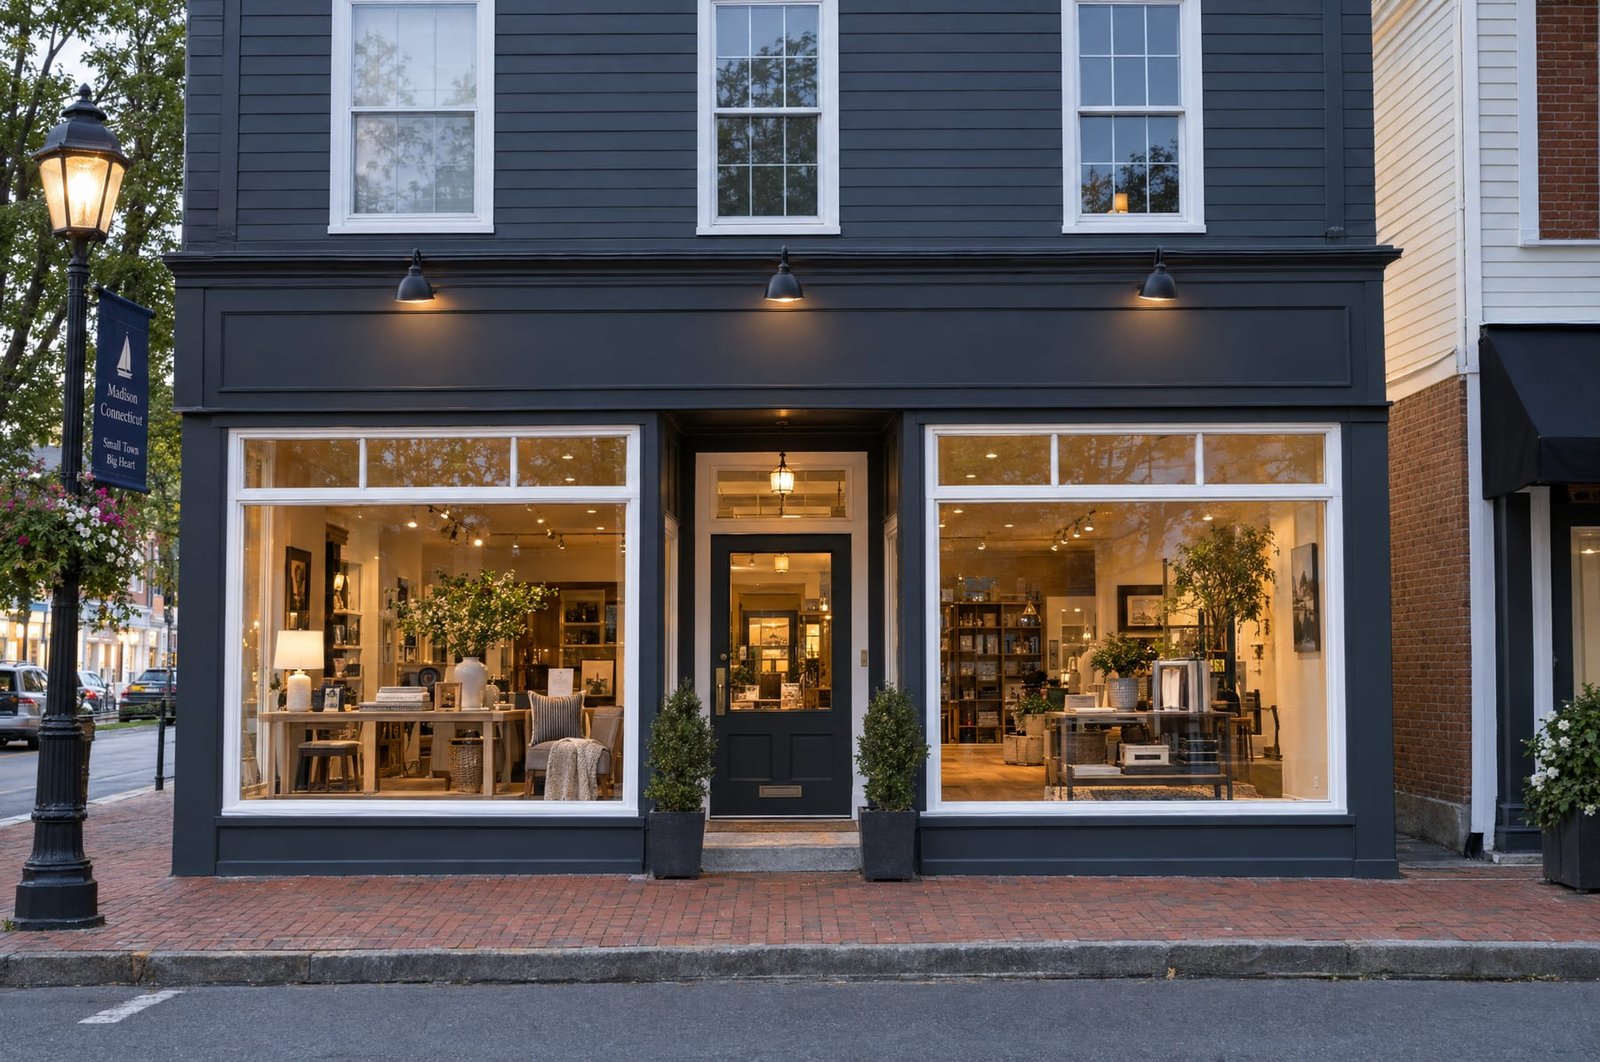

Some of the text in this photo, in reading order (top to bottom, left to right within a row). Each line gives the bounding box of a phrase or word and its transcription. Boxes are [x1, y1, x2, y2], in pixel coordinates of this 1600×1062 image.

[107, 383, 138, 404] Madison
[100, 402, 143, 426] Connecticut
[103, 437, 139, 456] Small Town
[106, 454, 136, 470] Big Heart
